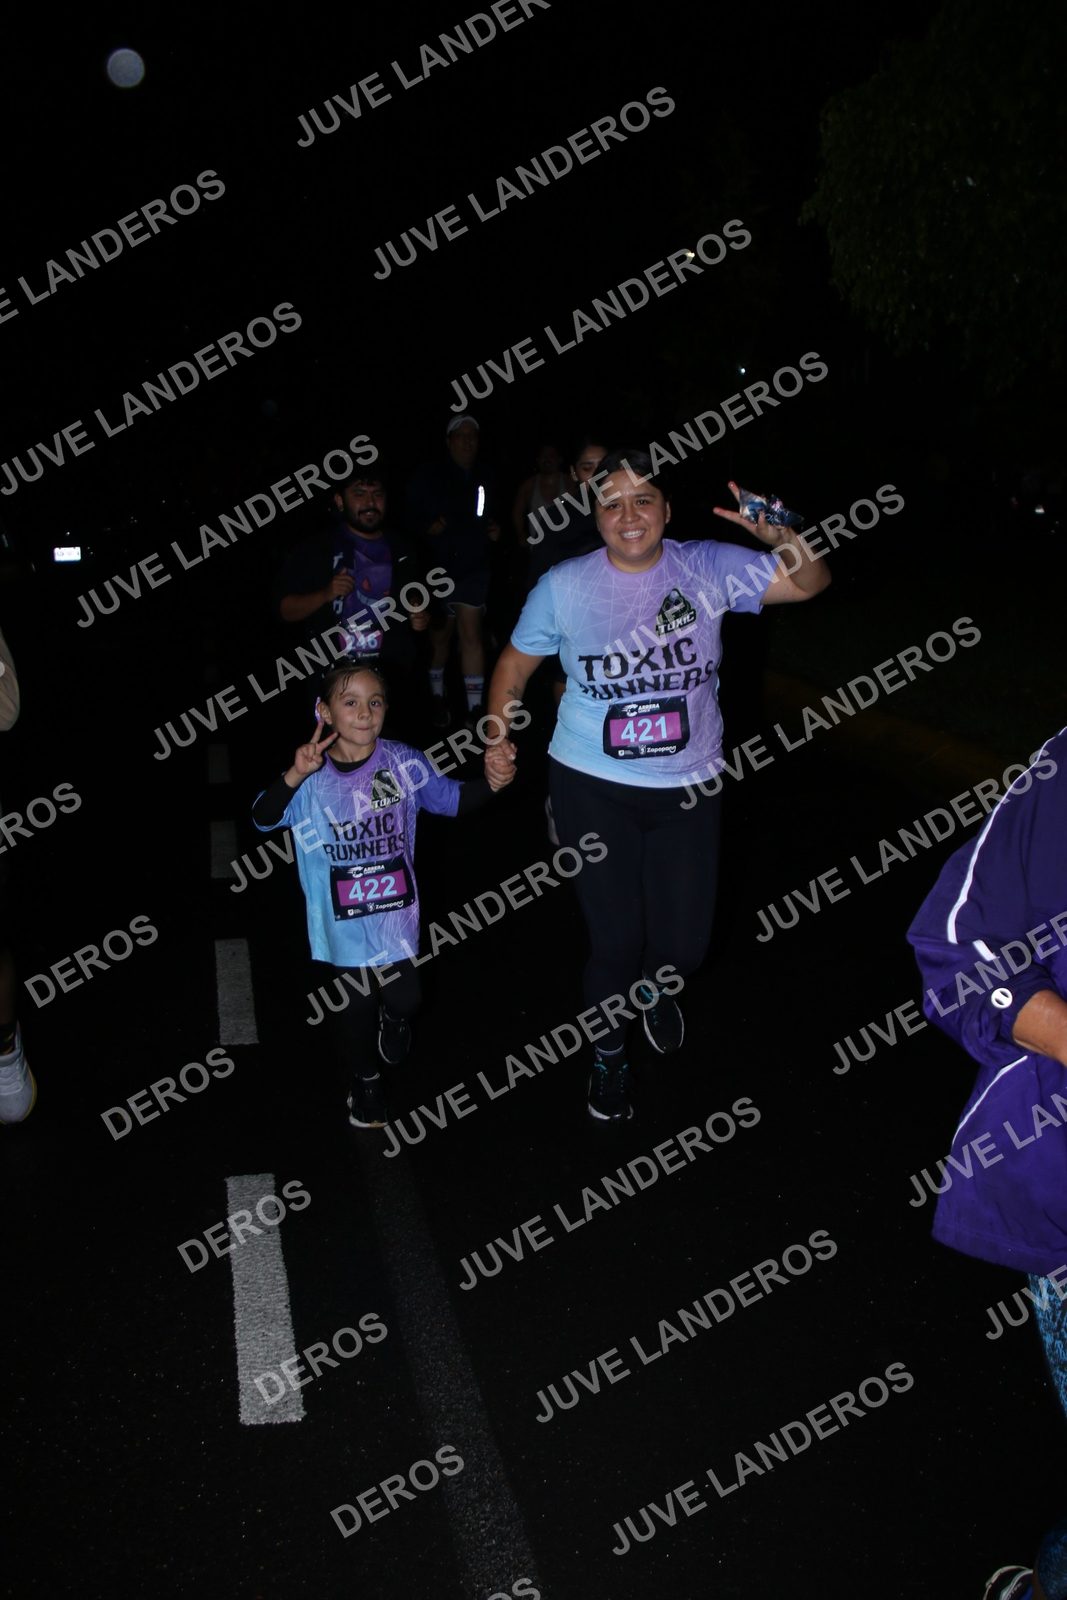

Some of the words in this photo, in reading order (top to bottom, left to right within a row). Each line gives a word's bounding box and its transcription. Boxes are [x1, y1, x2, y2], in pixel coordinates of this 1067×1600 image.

[657, 611, 695, 635] TOXIC
[578, 637, 698, 682] TOXIC
[621, 716, 668, 743] 421
[374, 793, 401, 809] TOXIC
[329, 812, 395, 842] TOXIC
[349, 876, 398, 902] 422
